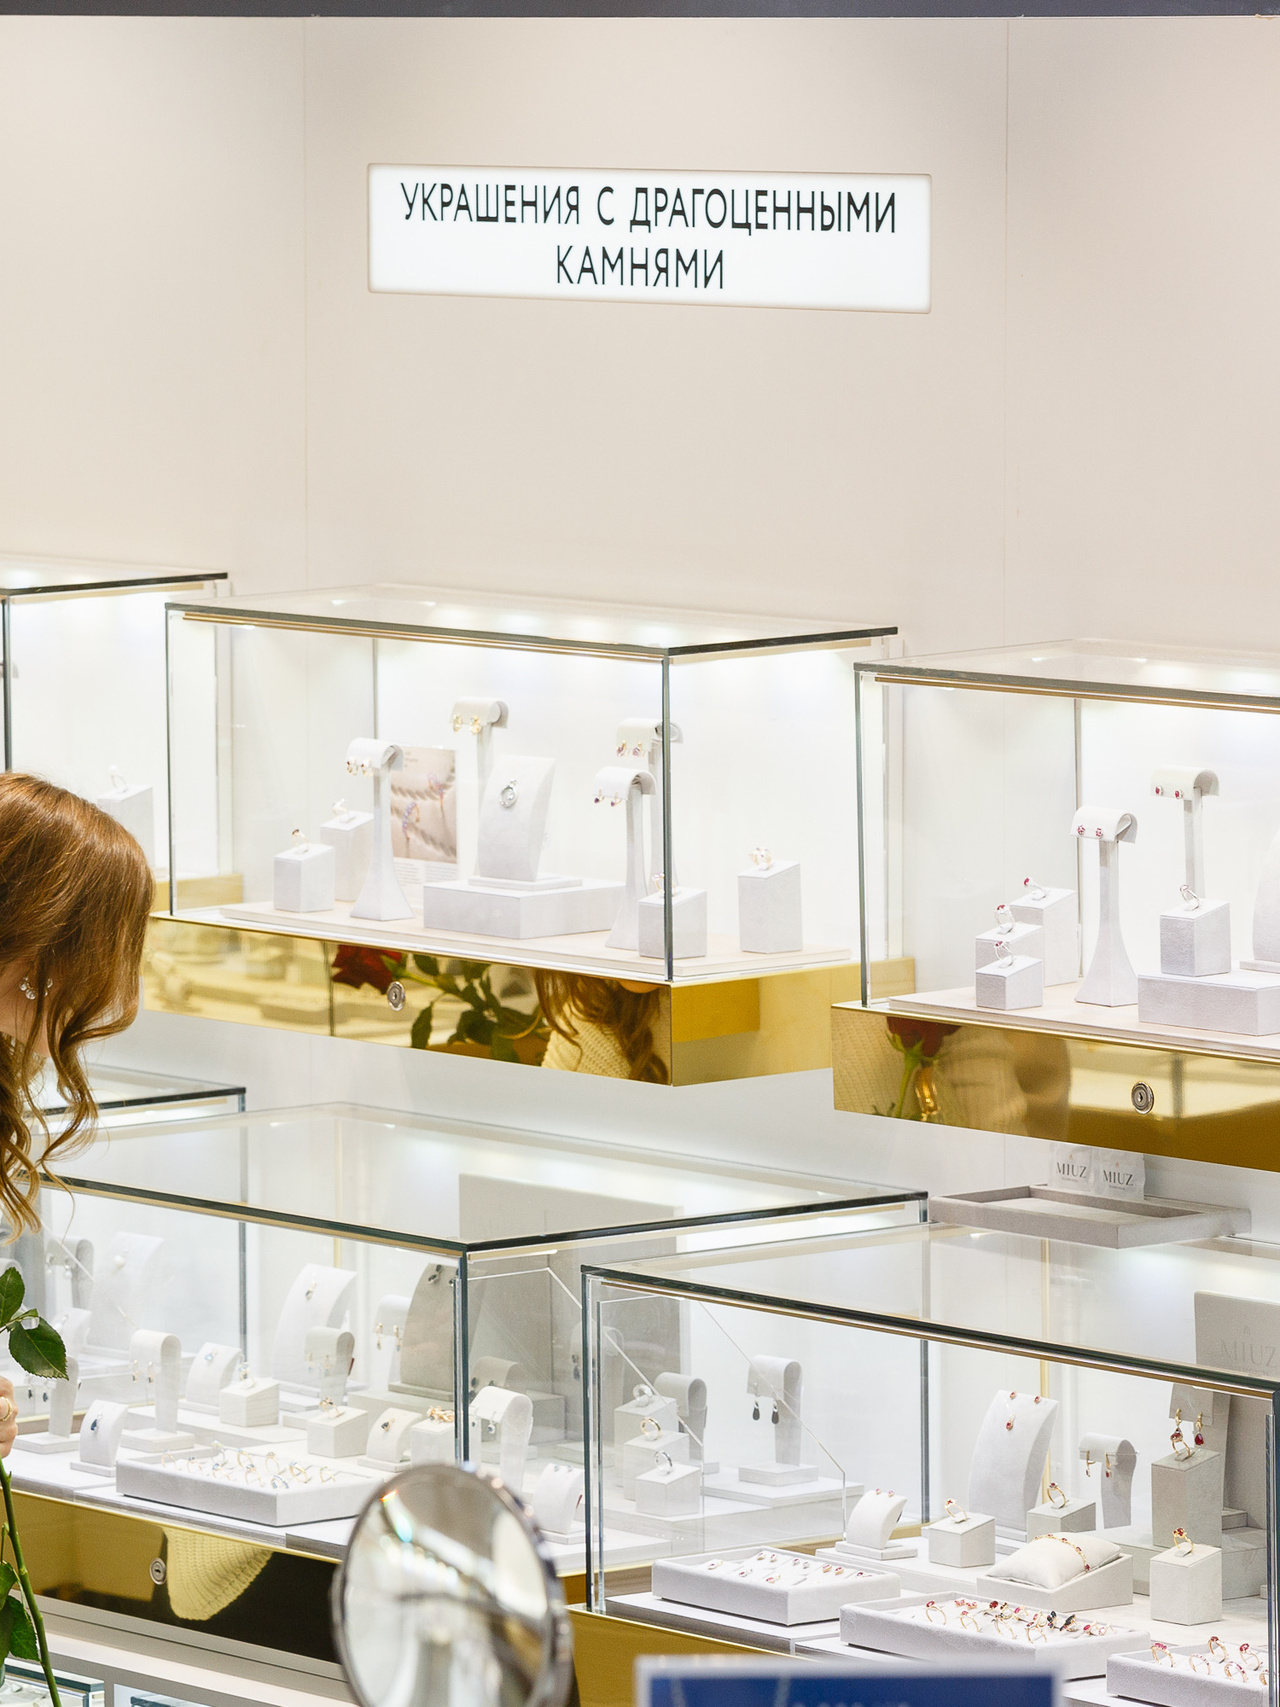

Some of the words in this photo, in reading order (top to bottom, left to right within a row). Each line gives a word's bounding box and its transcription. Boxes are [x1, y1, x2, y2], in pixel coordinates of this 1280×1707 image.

[400, 182, 580, 225] УКРАШЕНИЯ
[597, 186, 615, 226] С
[629, 187, 895, 237] ДРАГОЦЕННЫМИ
[556, 245, 723, 290] КАМНЯМИ
[1056, 1162, 1087, 1179] MIUZ
[1102, 1169, 1134, 1187] MIUZ
